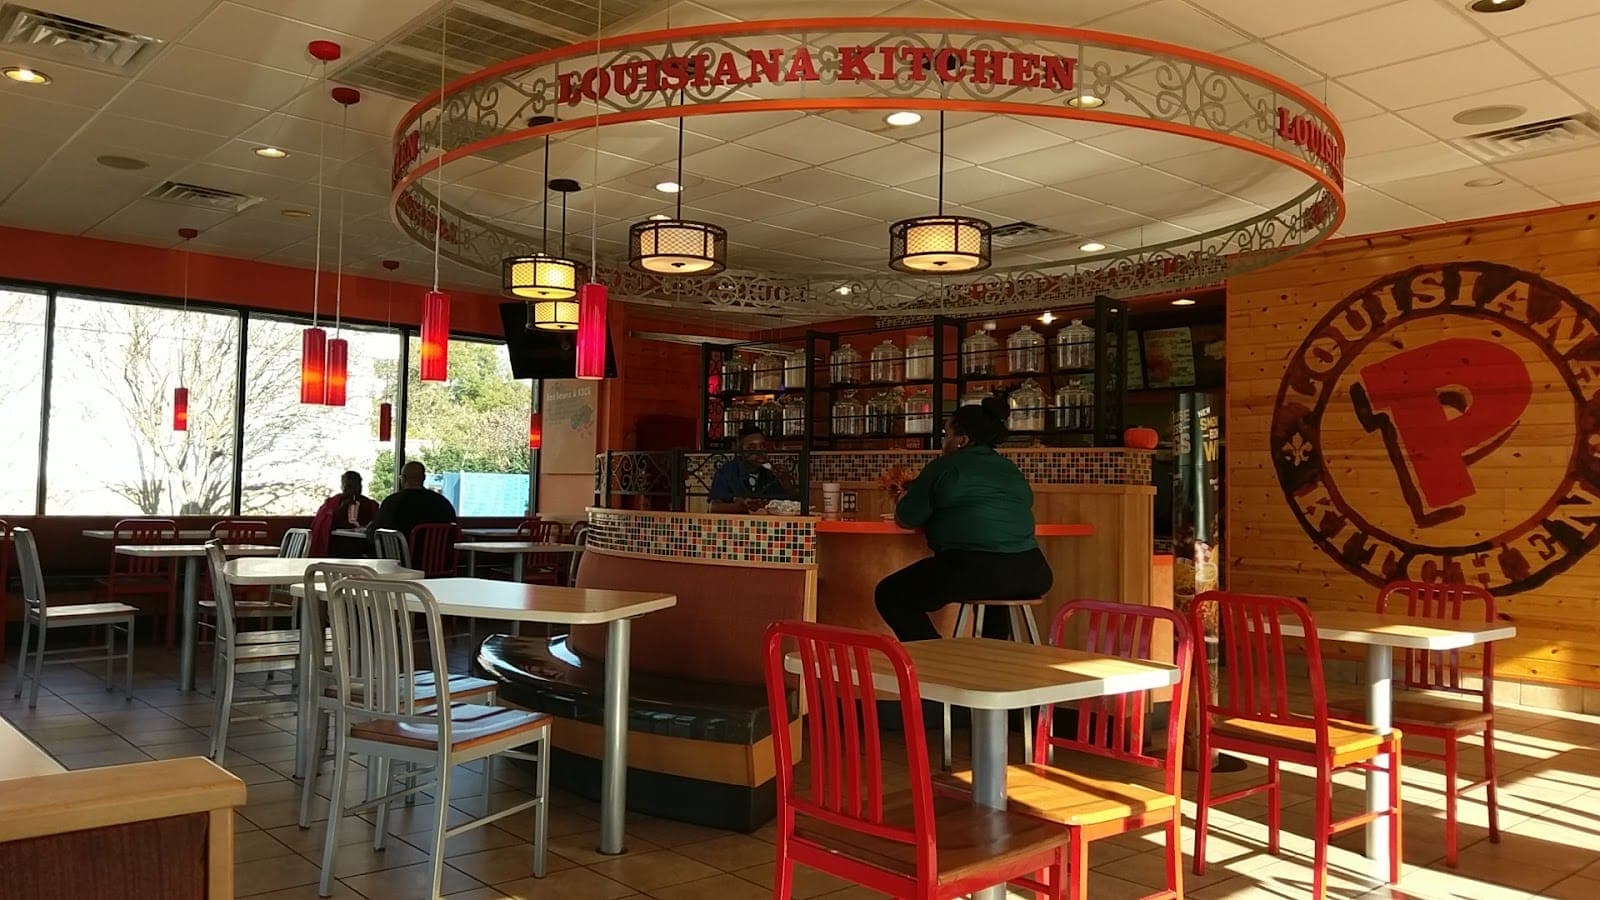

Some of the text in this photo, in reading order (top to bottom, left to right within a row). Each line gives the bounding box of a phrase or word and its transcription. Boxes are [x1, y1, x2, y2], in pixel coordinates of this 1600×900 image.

[557, 46, 1077, 105] LOUISIANA KITCHEN
[1351, 337, 1532, 528] P
[1294, 481, 1600, 587] KITCHEN
